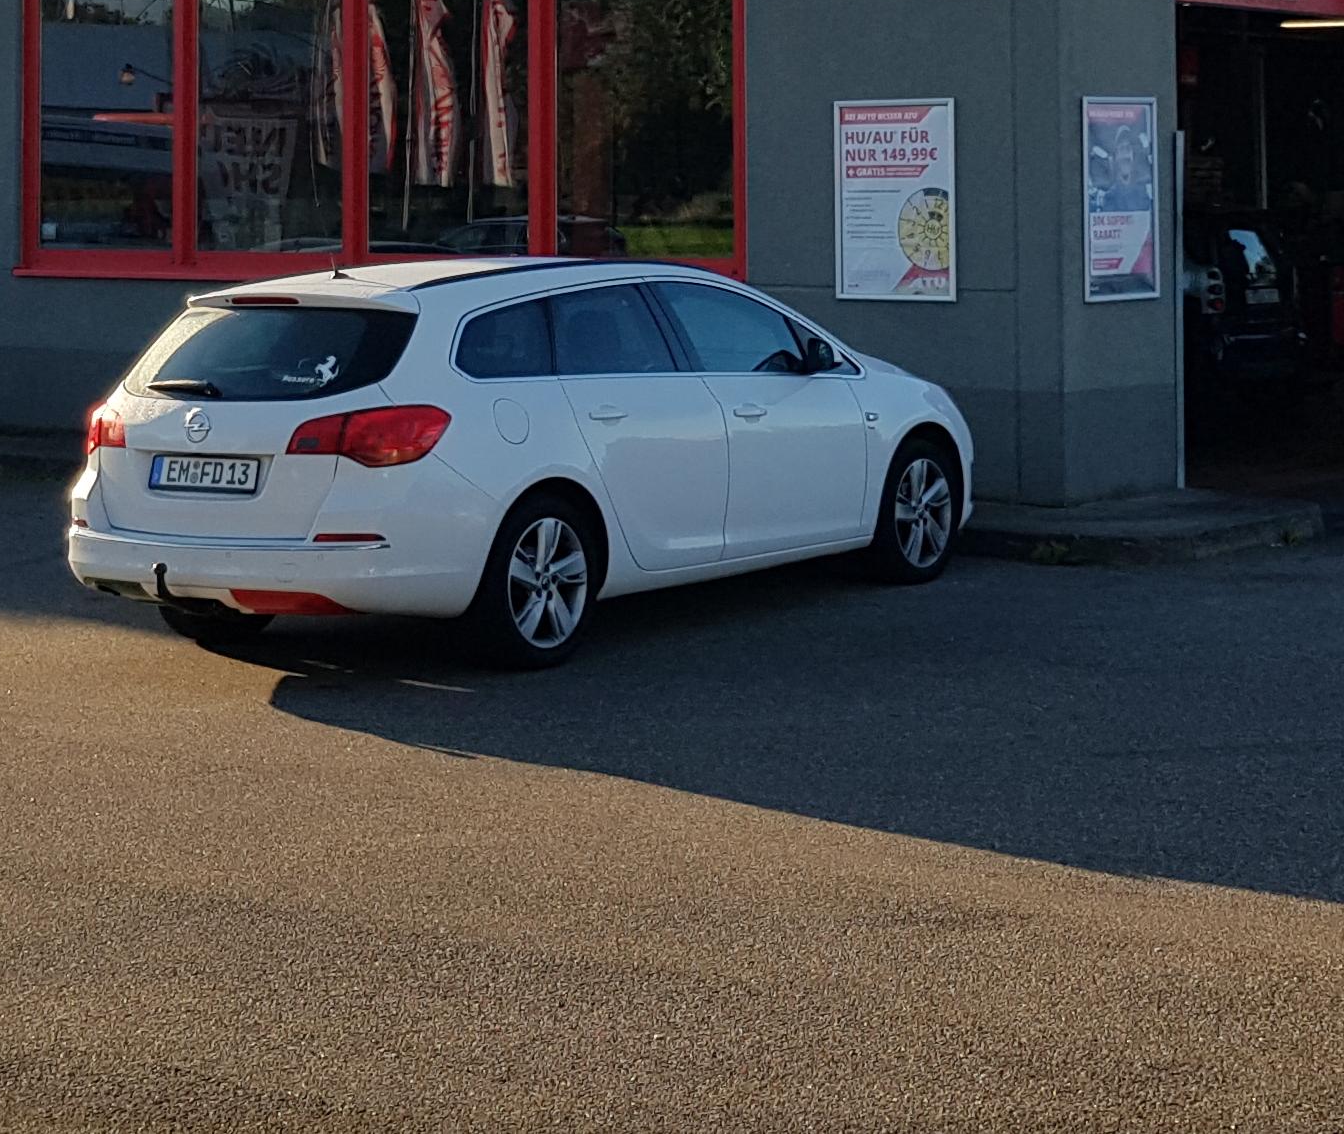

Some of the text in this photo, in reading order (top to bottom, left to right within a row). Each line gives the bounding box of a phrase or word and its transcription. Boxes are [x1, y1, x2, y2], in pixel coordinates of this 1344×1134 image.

[901, 126, 930, 144] FÜR
[845, 147, 938, 163] NUR 149,99€
[856, 167, 886, 177] GRATIS
[166, 460, 250, 486] EM FD 13
